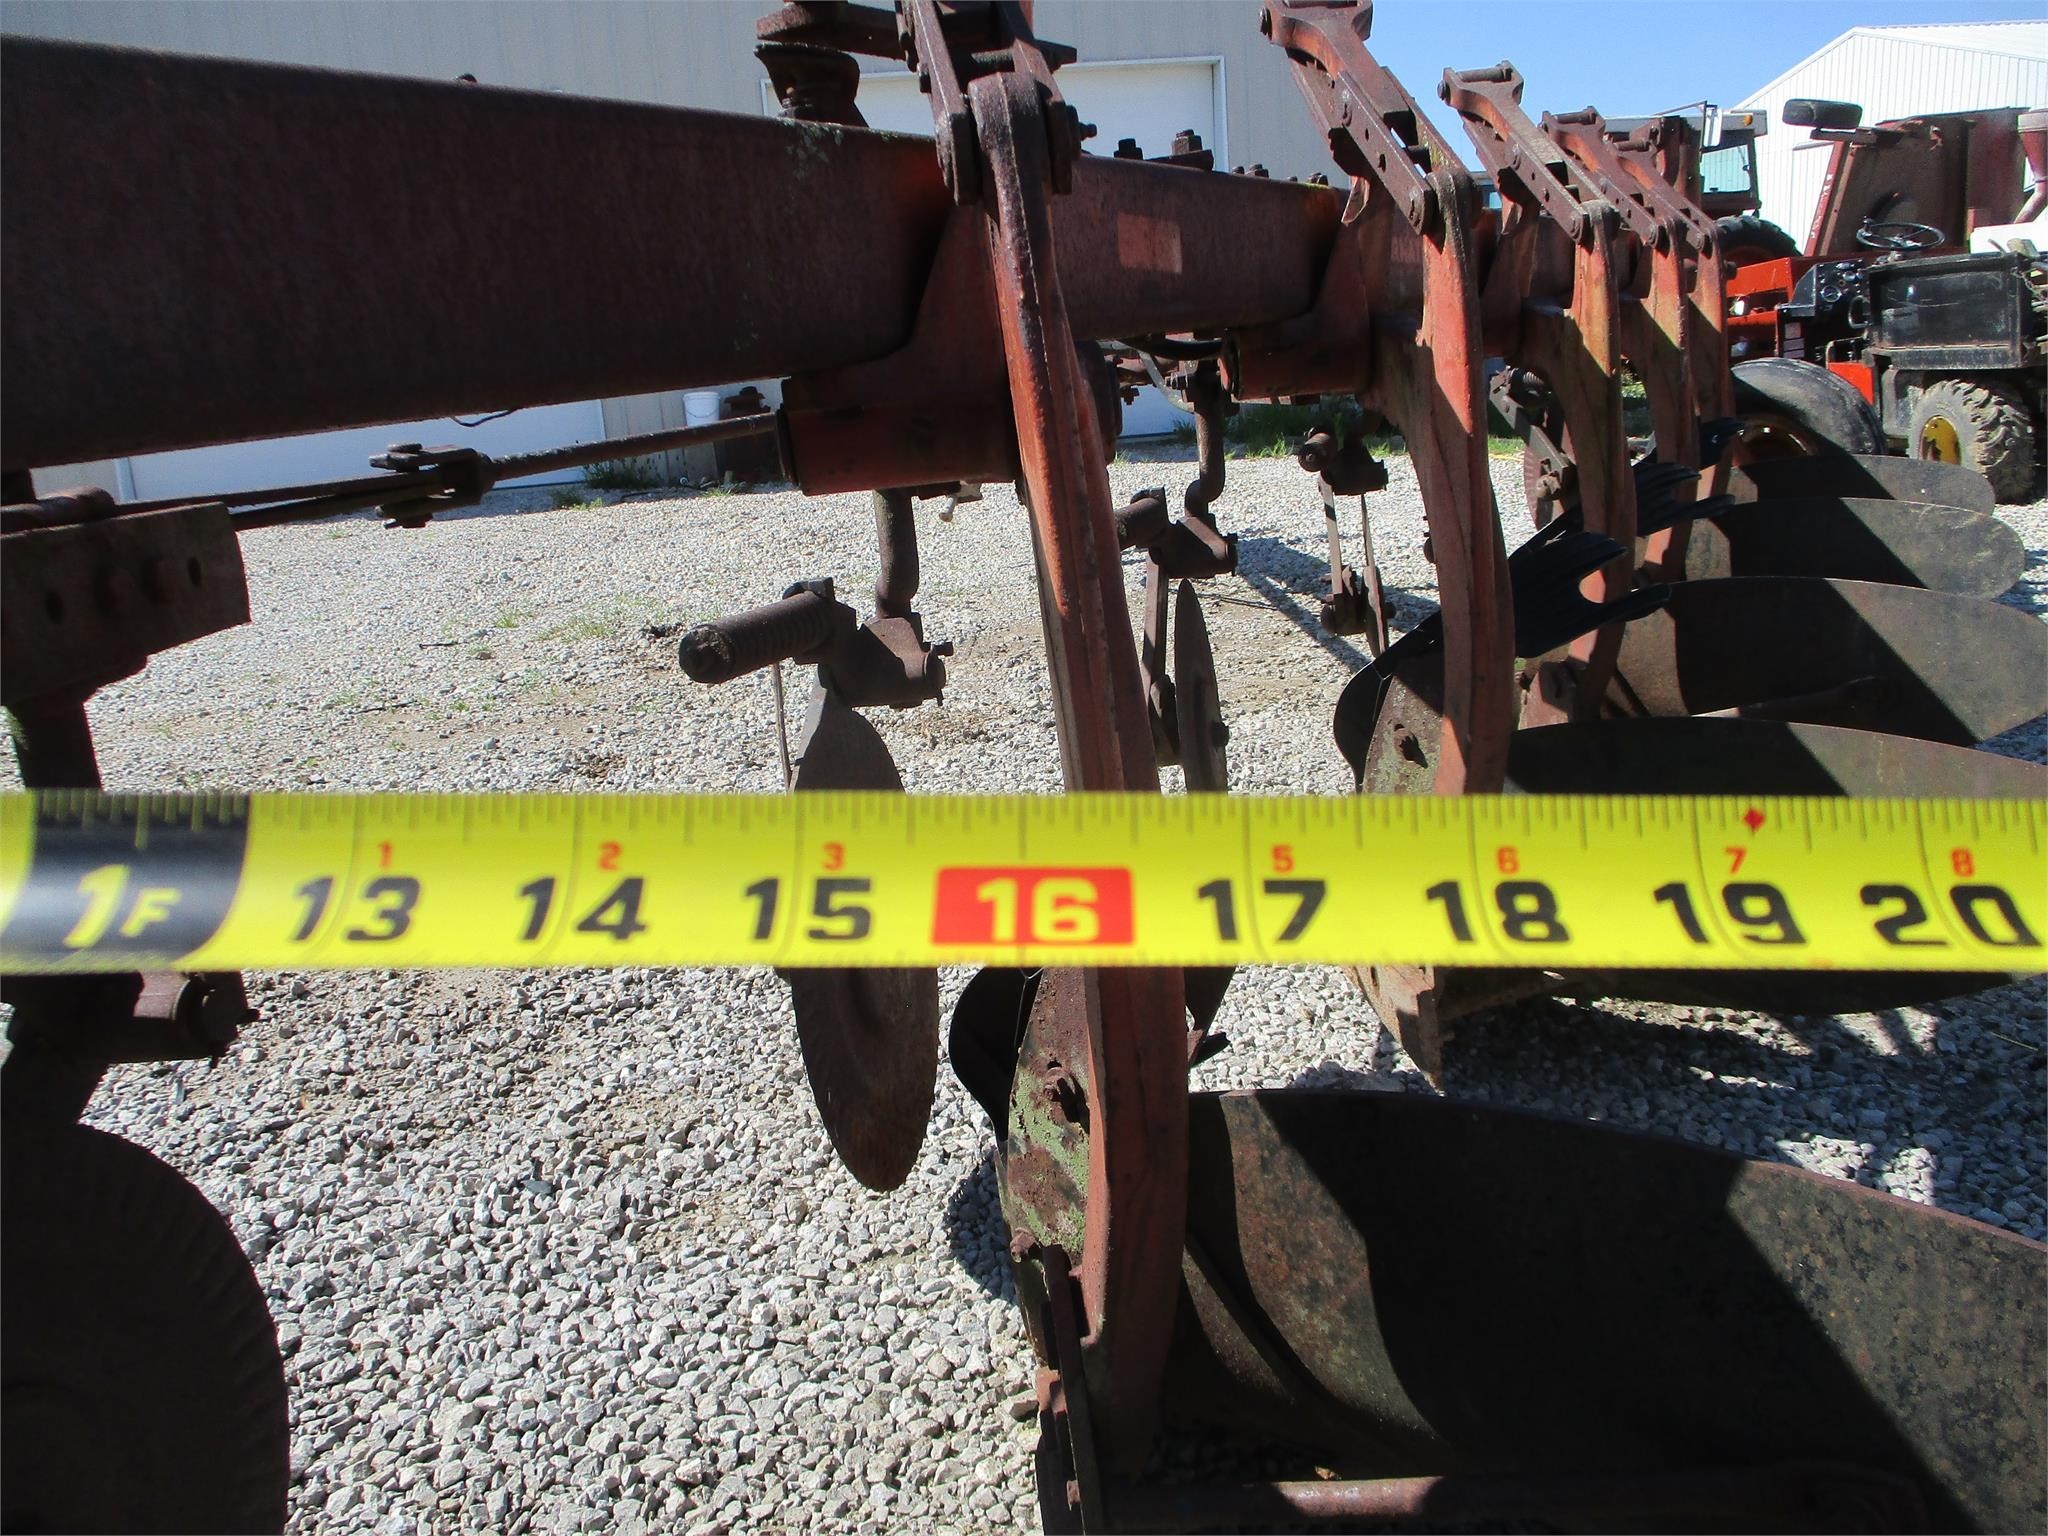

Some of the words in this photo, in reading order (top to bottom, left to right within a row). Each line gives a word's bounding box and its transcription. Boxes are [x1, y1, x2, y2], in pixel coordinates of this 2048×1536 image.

[377, 841, 393, 868] 1
[598, 841, 622, 870] 2
[824, 842, 845, 870] 3
[1271, 844, 1294, 873] 5
[1496, 845, 1520, 875] 6
[1724, 846, 1747, 874] 7
[1950, 847, 1975, 877] 8
[291, 876, 421, 942] 13
[518, 876, 648, 941] 14
[744, 877, 872, 941] 15
[977, 877, 1100, 942] 16
[1197, 878, 1327, 942] 17
[1425, 880, 1570, 943] 18
[1652, 881, 1807, 945] 19
[1858, 883, 2044, 947] 20
